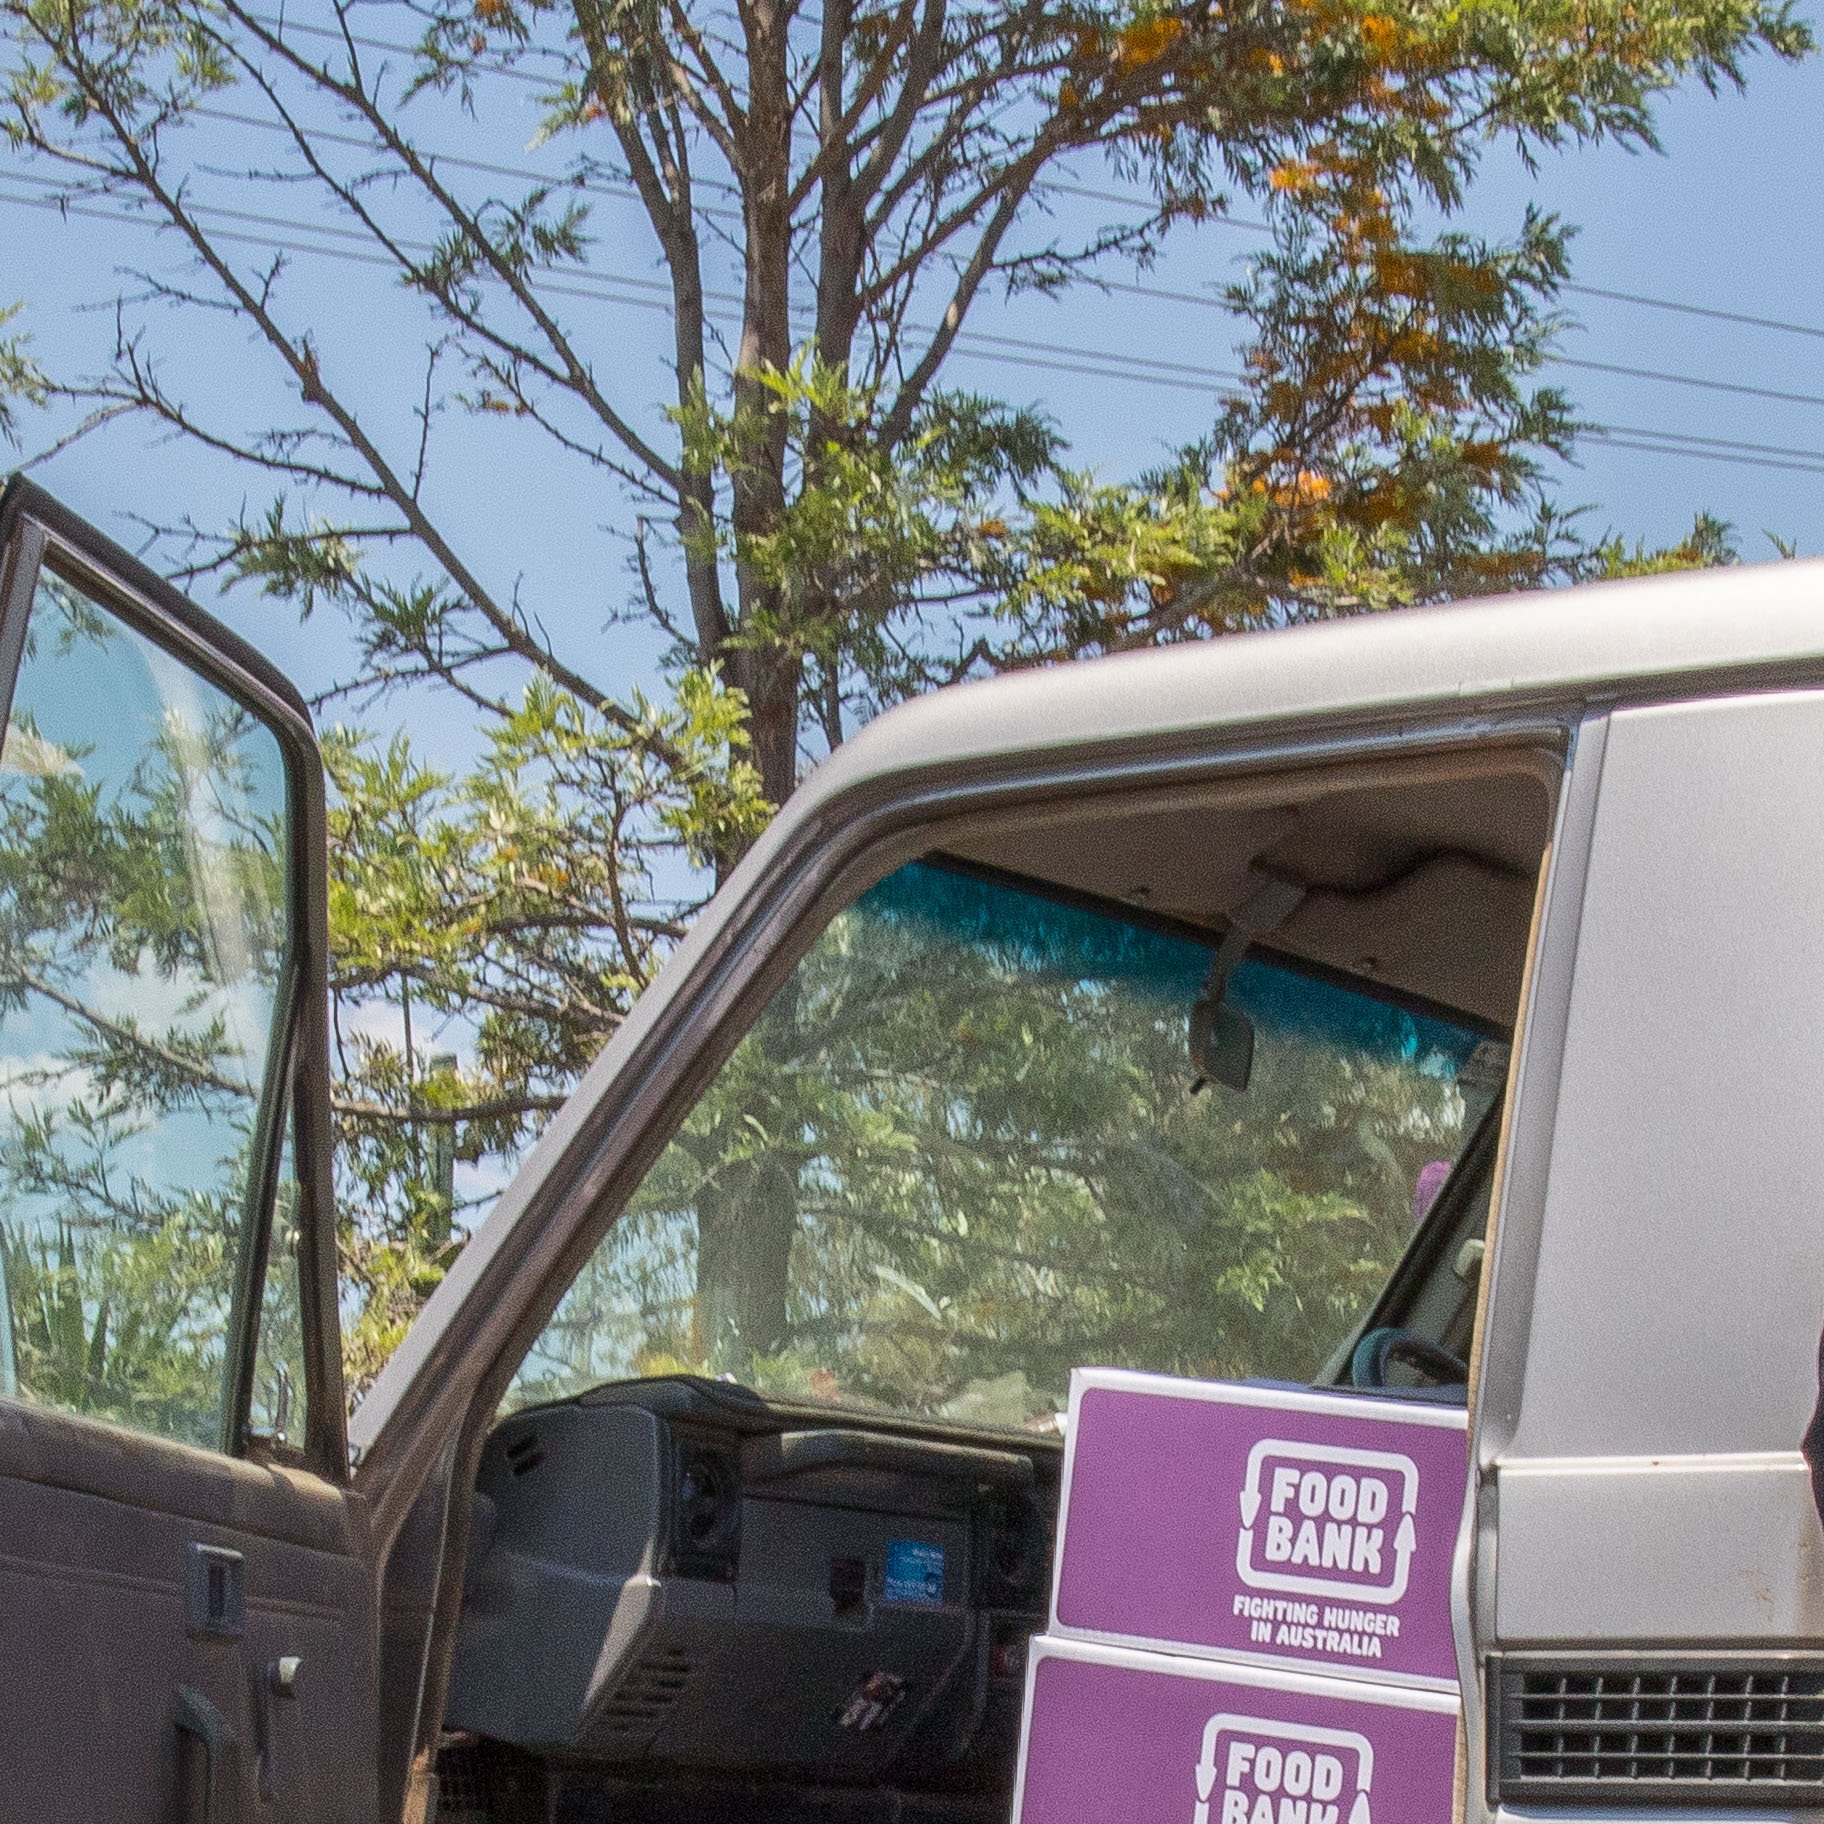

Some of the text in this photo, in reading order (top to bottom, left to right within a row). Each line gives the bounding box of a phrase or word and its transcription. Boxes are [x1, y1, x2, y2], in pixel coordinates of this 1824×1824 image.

[1269, 1467, 1389, 1525] FOOD
[1265, 1515, 1384, 1574] BANK
[1233, 1595, 1401, 1638] FIGHTING HUNGER
[1250, 1619, 1382, 1659] IN AUSTRALIA
[1226, 1740, 1344, 1798] FOOD
